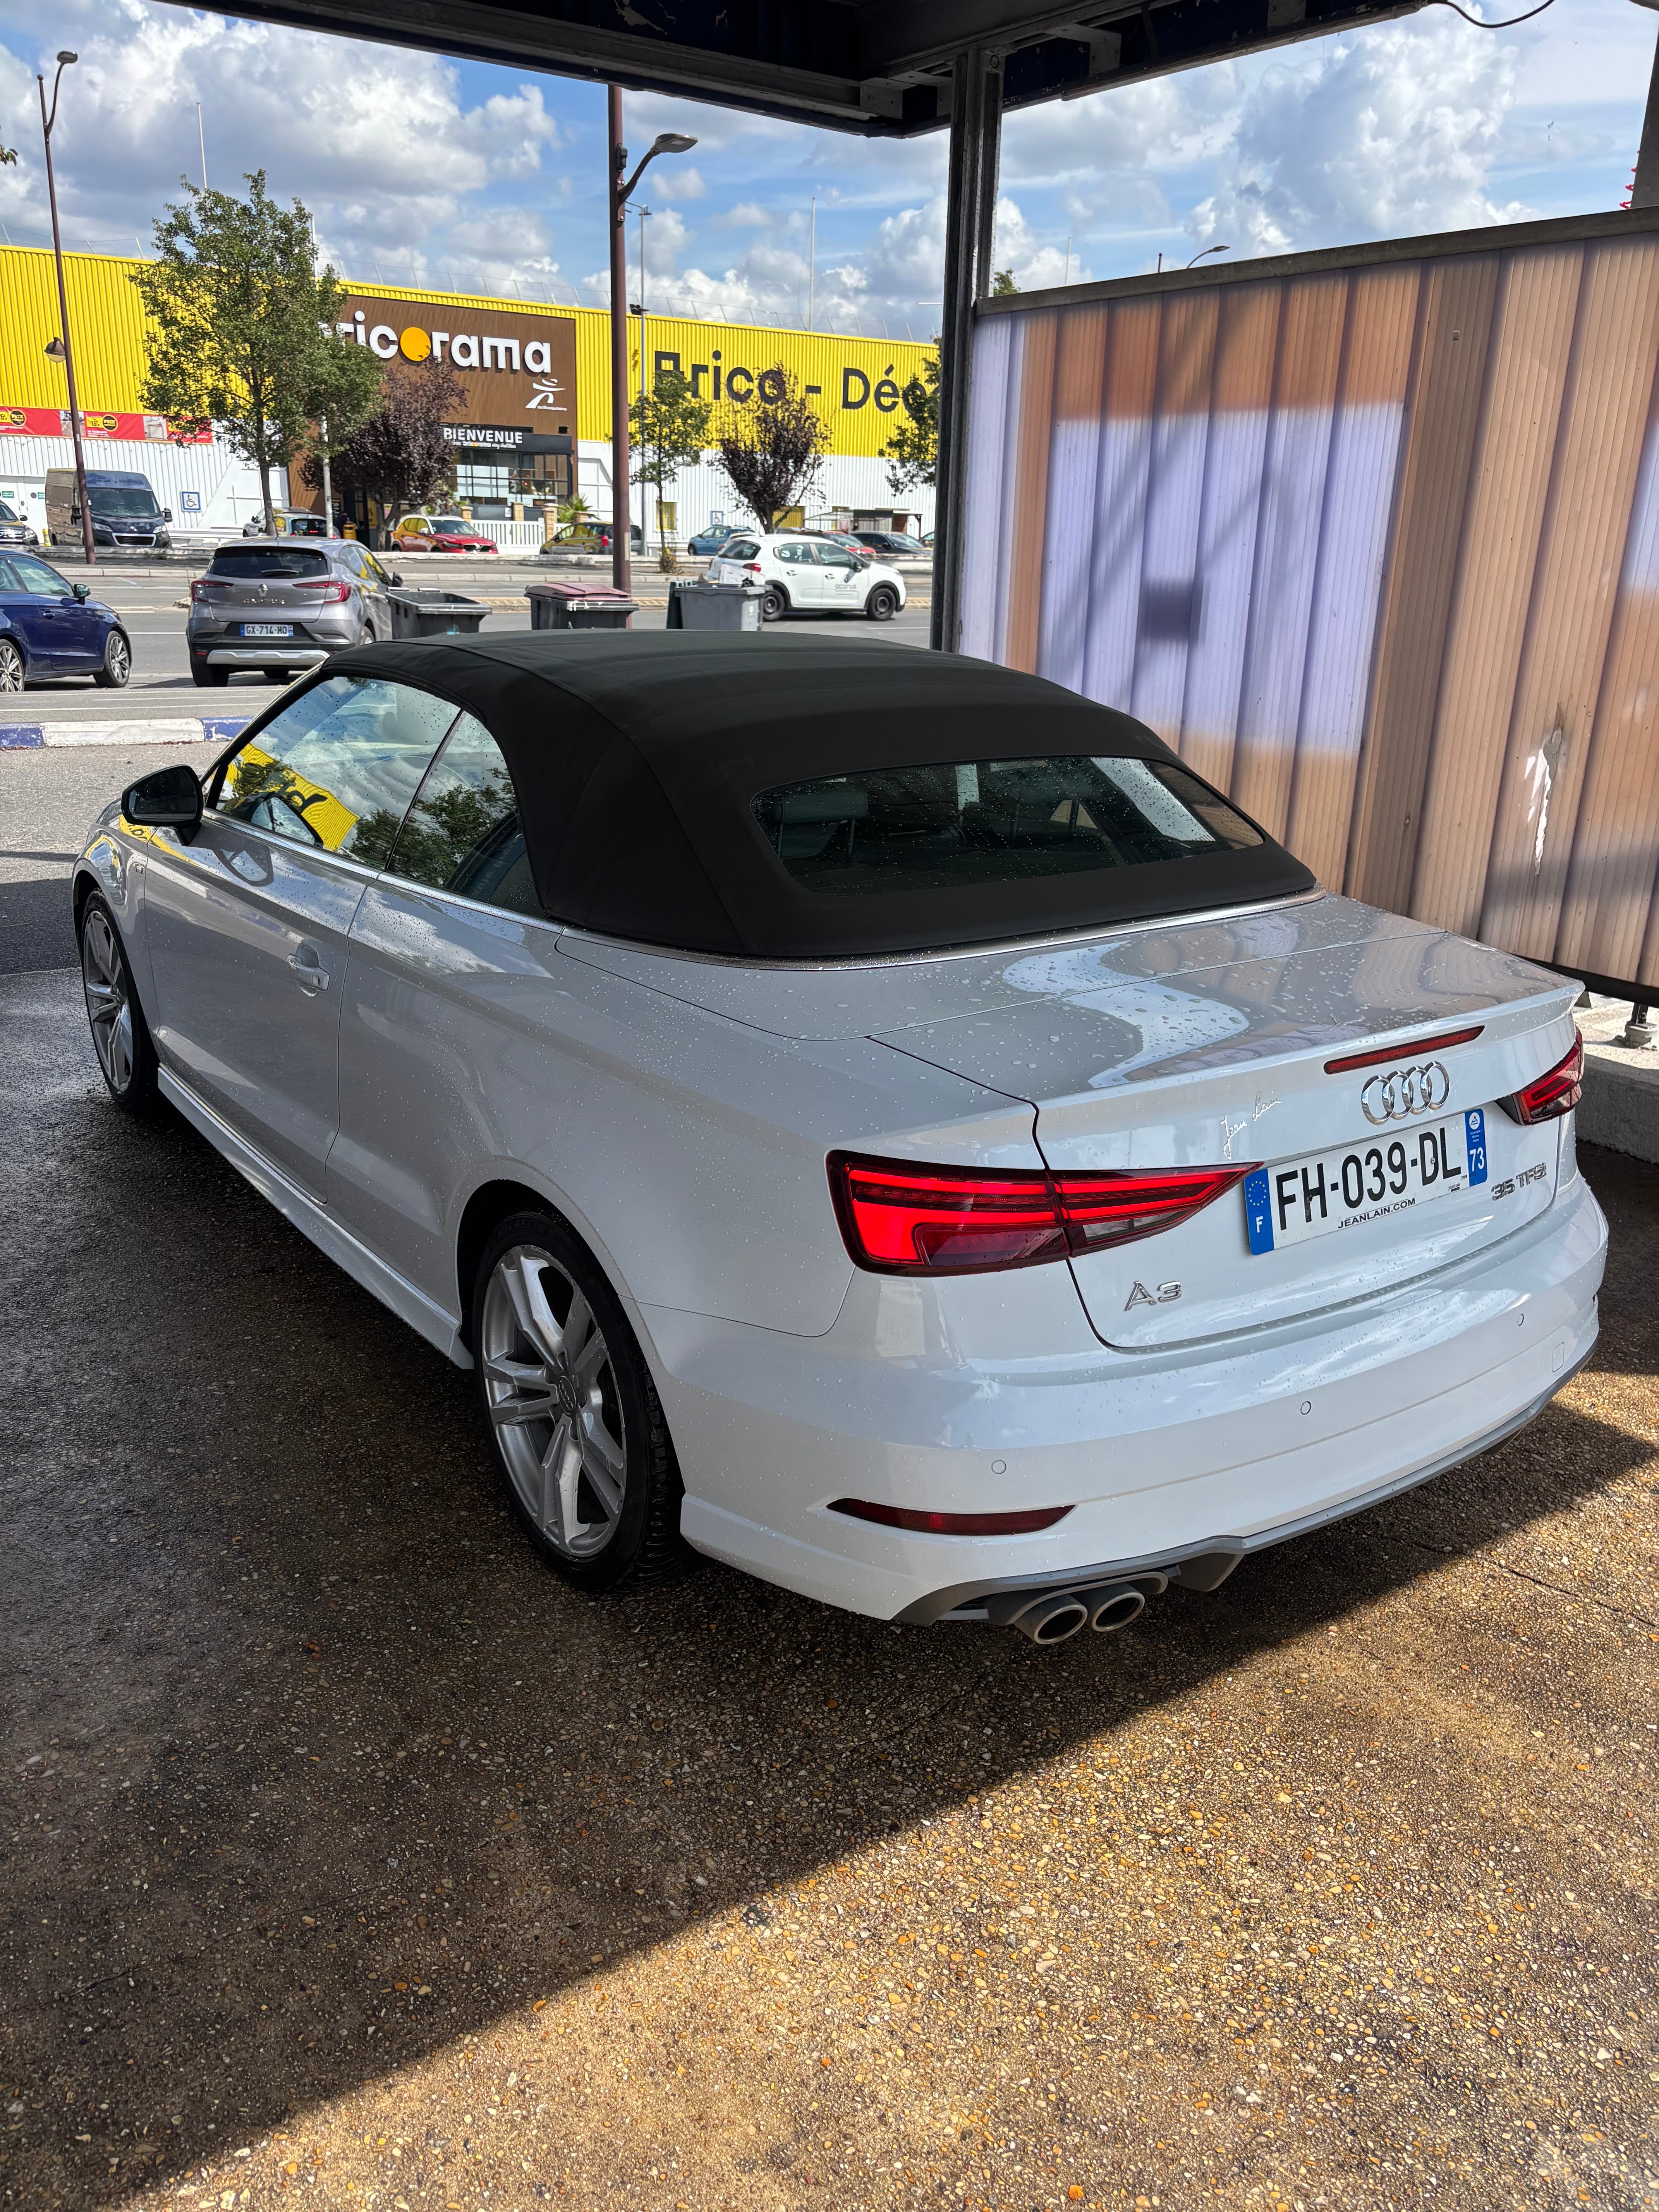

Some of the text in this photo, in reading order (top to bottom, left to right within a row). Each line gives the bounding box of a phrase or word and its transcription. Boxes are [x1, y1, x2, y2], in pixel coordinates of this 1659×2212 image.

[443, 428, 522, 443] BIENVENUE
[1470, 1147, 1485, 1172] 73
[1276, 1127, 1462, 1231] FH-039-DL
[1491, 1163, 1547, 1201] 35 TFSI
[1256, 1216, 1263, 1233] F
[1338, 1198, 1416, 1229] JEANLAIN.COM
[1124, 1281, 1182, 1312] A3
